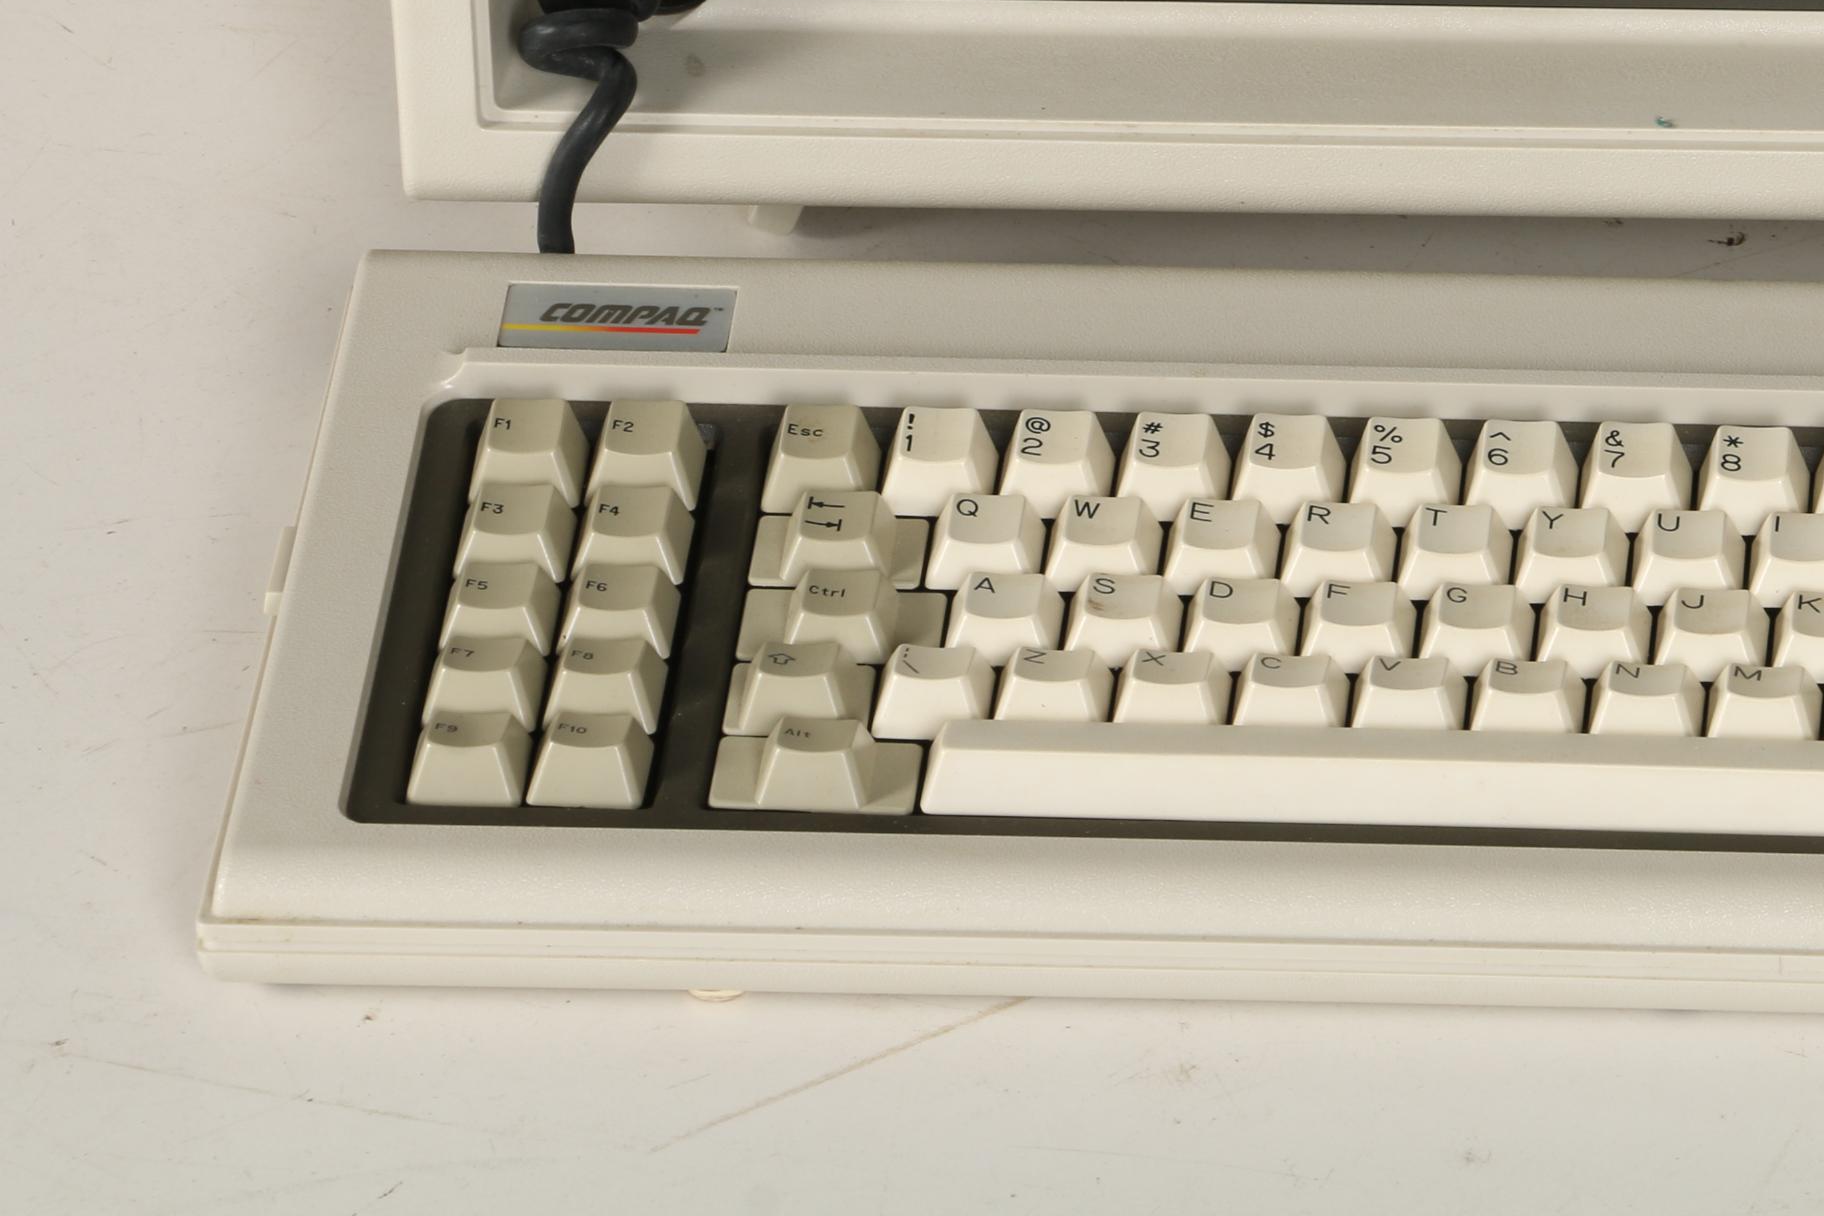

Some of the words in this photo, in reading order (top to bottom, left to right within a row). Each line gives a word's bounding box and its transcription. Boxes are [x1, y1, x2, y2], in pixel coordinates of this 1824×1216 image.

[540, 303, 711, 326] COMPAQ
[494, 418, 511, 429] F1
[612, 420, 634, 432] F2
[787, 424, 823, 437] Esc
[1025, 417, 1051, 434] @
[1143, 422, 1163, 434] #
[1258, 422, 1274, 438] $
[1374, 425, 1403, 443] %
[1605, 430, 1624, 447] &
[906, 435, 912, 451] 1
[1021, 438, 1043, 456] 2
[1139, 439, 1160, 457] 3
[1255, 443, 1275, 460] 4
[1371, 445, 1392, 464] 5
[1488, 448, 1508, 465] 6
[1604, 450, 1624, 468] 7
[1721, 454, 1741, 471] 8
[481, 502, 504, 514] F3
[599, 504, 619, 516] F4
[956, 499, 978, 517] Q
[1075, 499, 1100, 519] W
[1190, 502, 1213, 522] E
[1307, 505, 1331, 524] R
[1426, 508, 1447, 526] T
[1542, 511, 1563, 529] Y
[1658, 513, 1680, 531] U
[1775, 516, 1780, 532] I
[465, 579, 487, 590] F5
[586, 580, 607, 591] F6
[809, 585, 845, 597] Ctrl
[974, 577, 995, 593] A
[1093, 578, 1115, 594] S
[1209, 581, 1233, 598] D
[1327, 584, 1350, 598] F
[1447, 587, 1467, 603] G
[1563, 588, 1587, 606] H
[1681, 595, 1704, 609] J
[1798, 595, 1821, 613] K
[450, 648, 474, 657] F7
[571, 650, 594, 660] F8
[1024, 649, 1046, 664] Z
[1142, 652, 1166, 666] X
[1261, 657, 1281, 669] C
[1379, 658, 1401, 671] V
[1496, 661, 1518, 675] B
[1616, 664, 1640, 678] N
[1734, 666, 1762, 681] M
[435, 723, 458, 732] F9
[558, 723, 587, 734] F10
[784, 728, 810, 738] Alt
